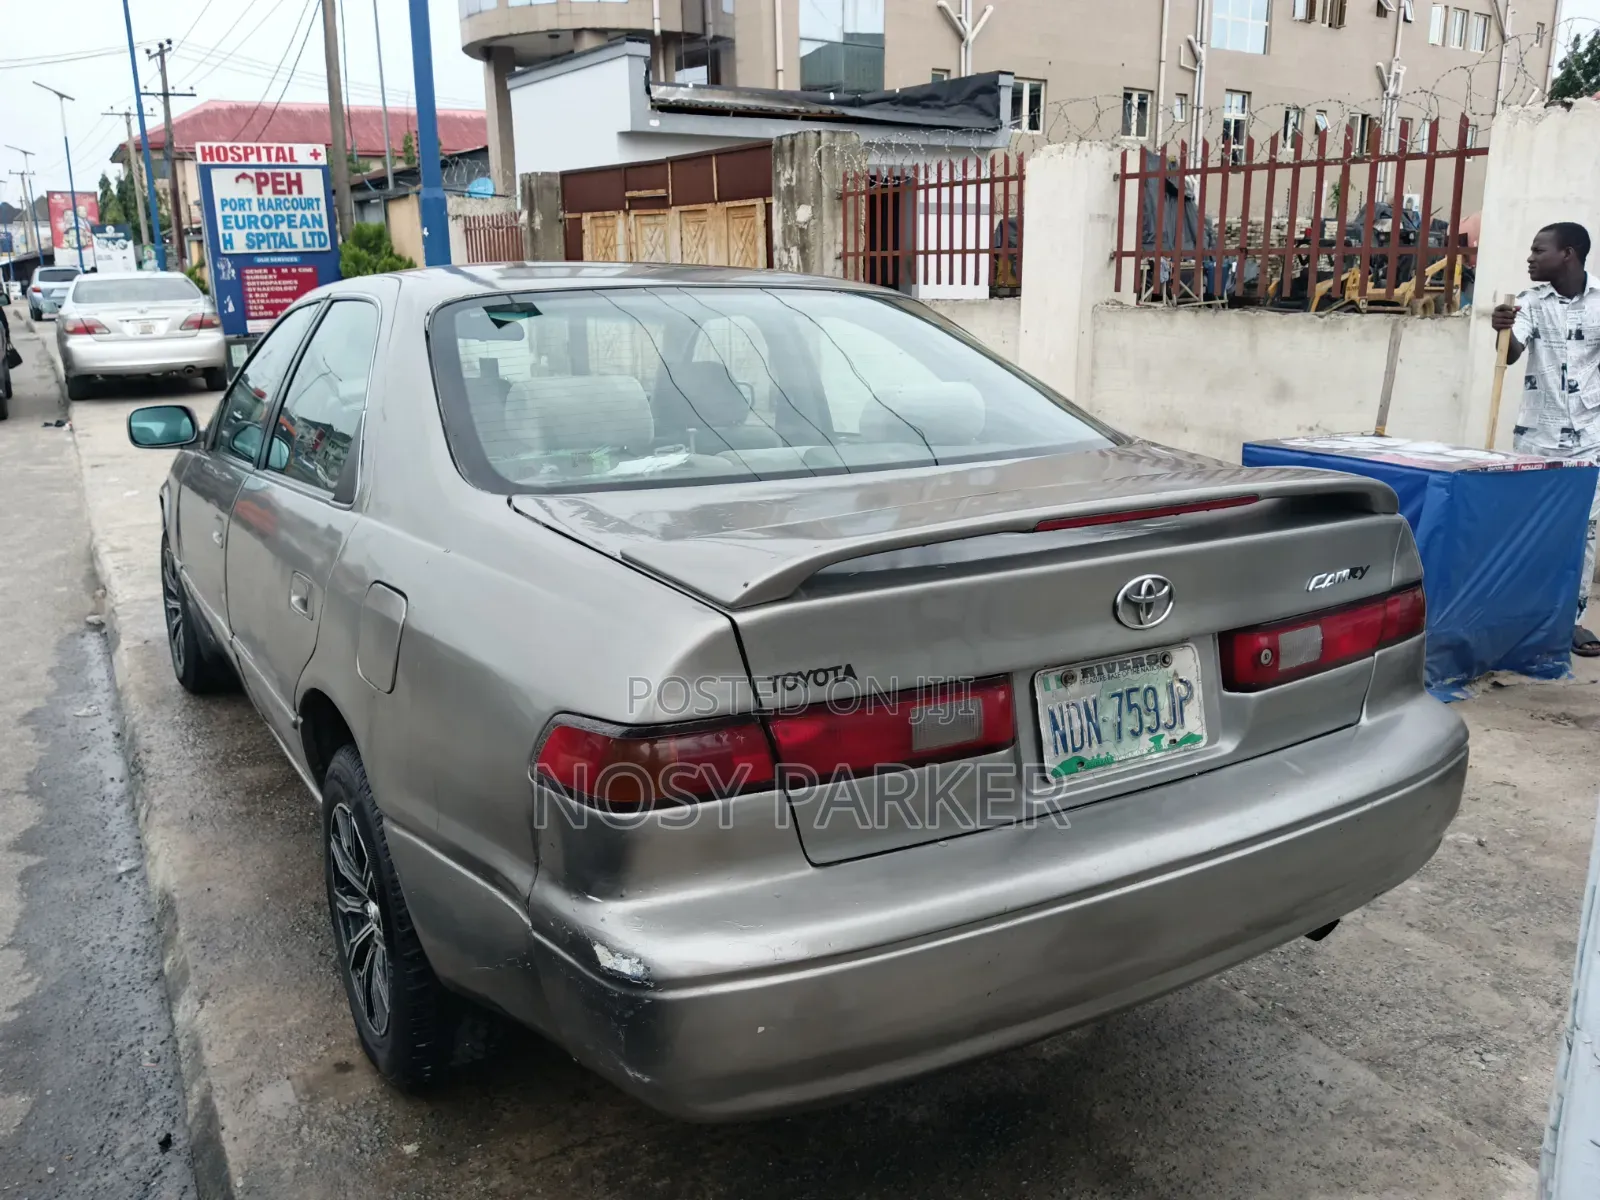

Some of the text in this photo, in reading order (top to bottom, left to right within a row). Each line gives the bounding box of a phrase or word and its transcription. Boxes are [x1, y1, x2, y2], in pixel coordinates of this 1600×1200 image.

[200, 145, 298, 163] HOSPITAL
[254, 172, 304, 196] PEH
[220, 197, 321, 212] PORT HARCOURT
[221, 213, 324, 230] EUROPEAN
[222, 231, 328, 250] HSPITAL LTD
[1304, 565, 1370, 592] CAMRY
[767, 663, 857, 693] TOYOTA
[1048, 694, 1101, 757] NDN
